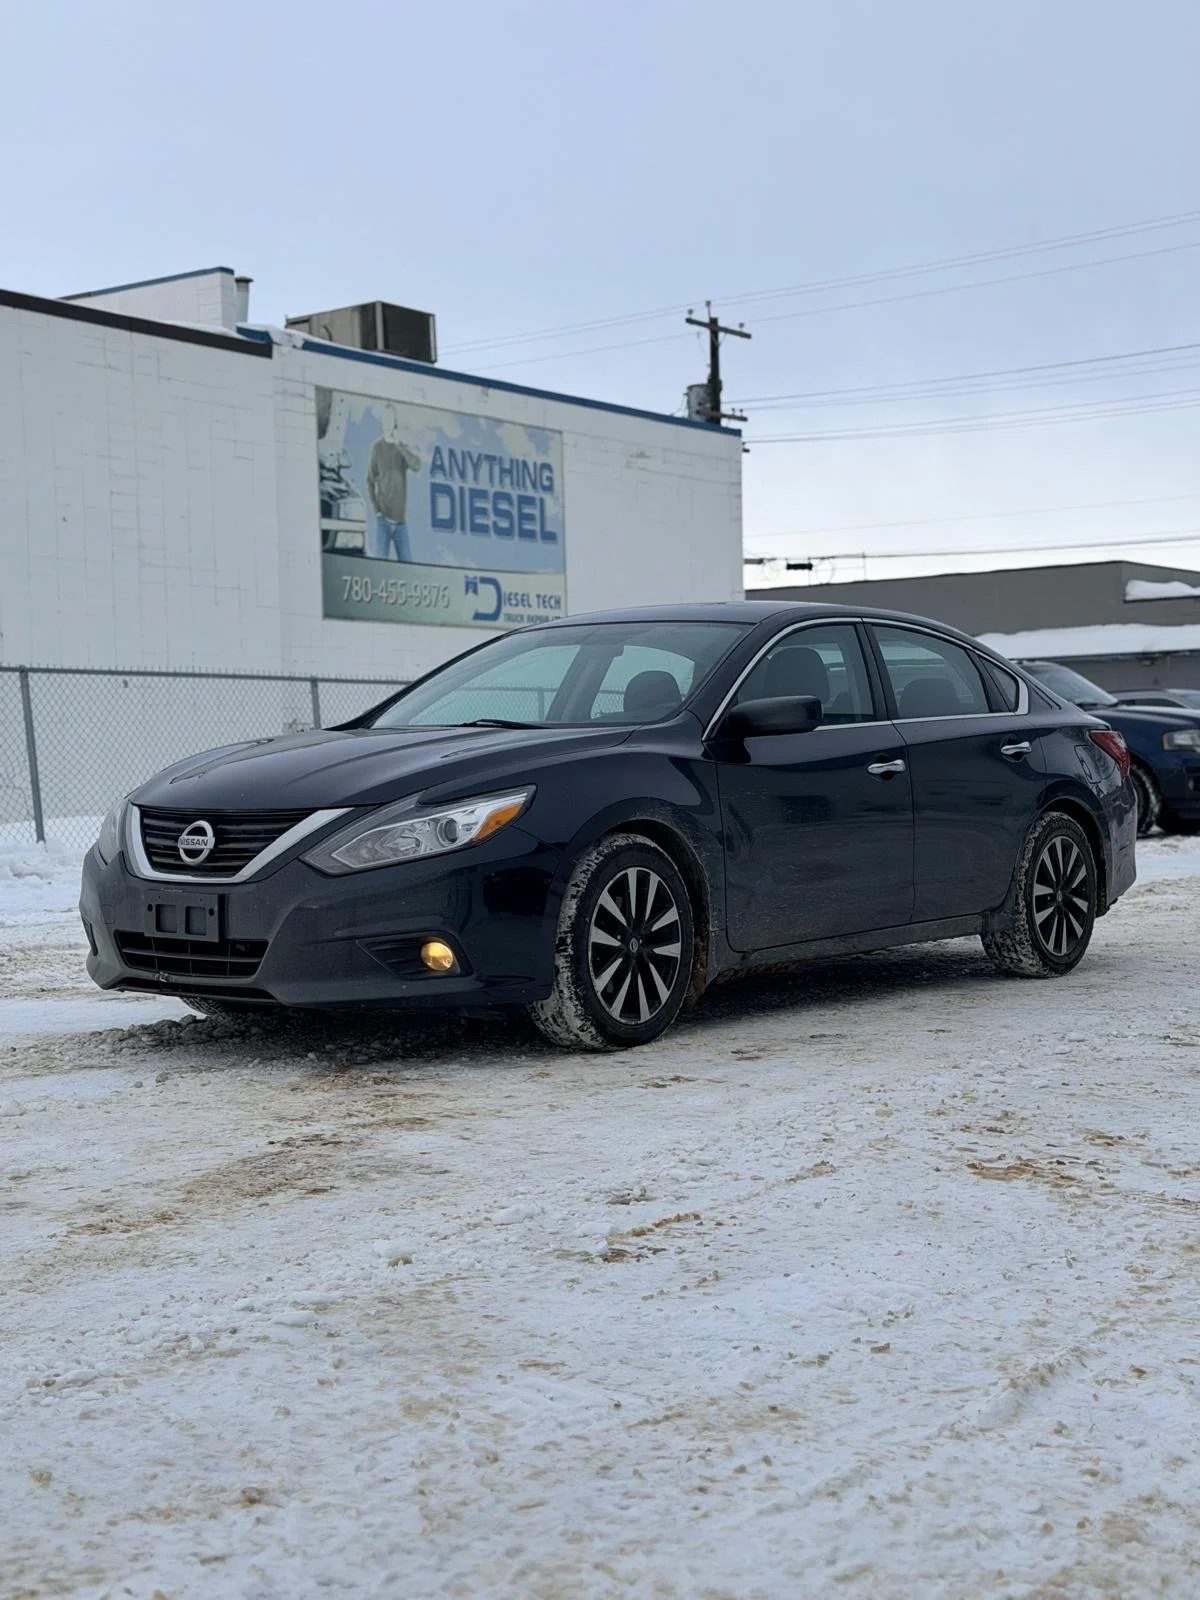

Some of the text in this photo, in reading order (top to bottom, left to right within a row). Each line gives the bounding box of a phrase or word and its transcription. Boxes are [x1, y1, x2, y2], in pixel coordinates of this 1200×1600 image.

[430, 445, 554, 493] ANYTHING
[429, 481, 557, 543] DIESEL
[342, 575, 450, 608] 780-455-9876
[535, 593, 562, 610] TECH
[503, 613, 525, 623] TRUCK
[180, 838, 209, 847] NISSAN
